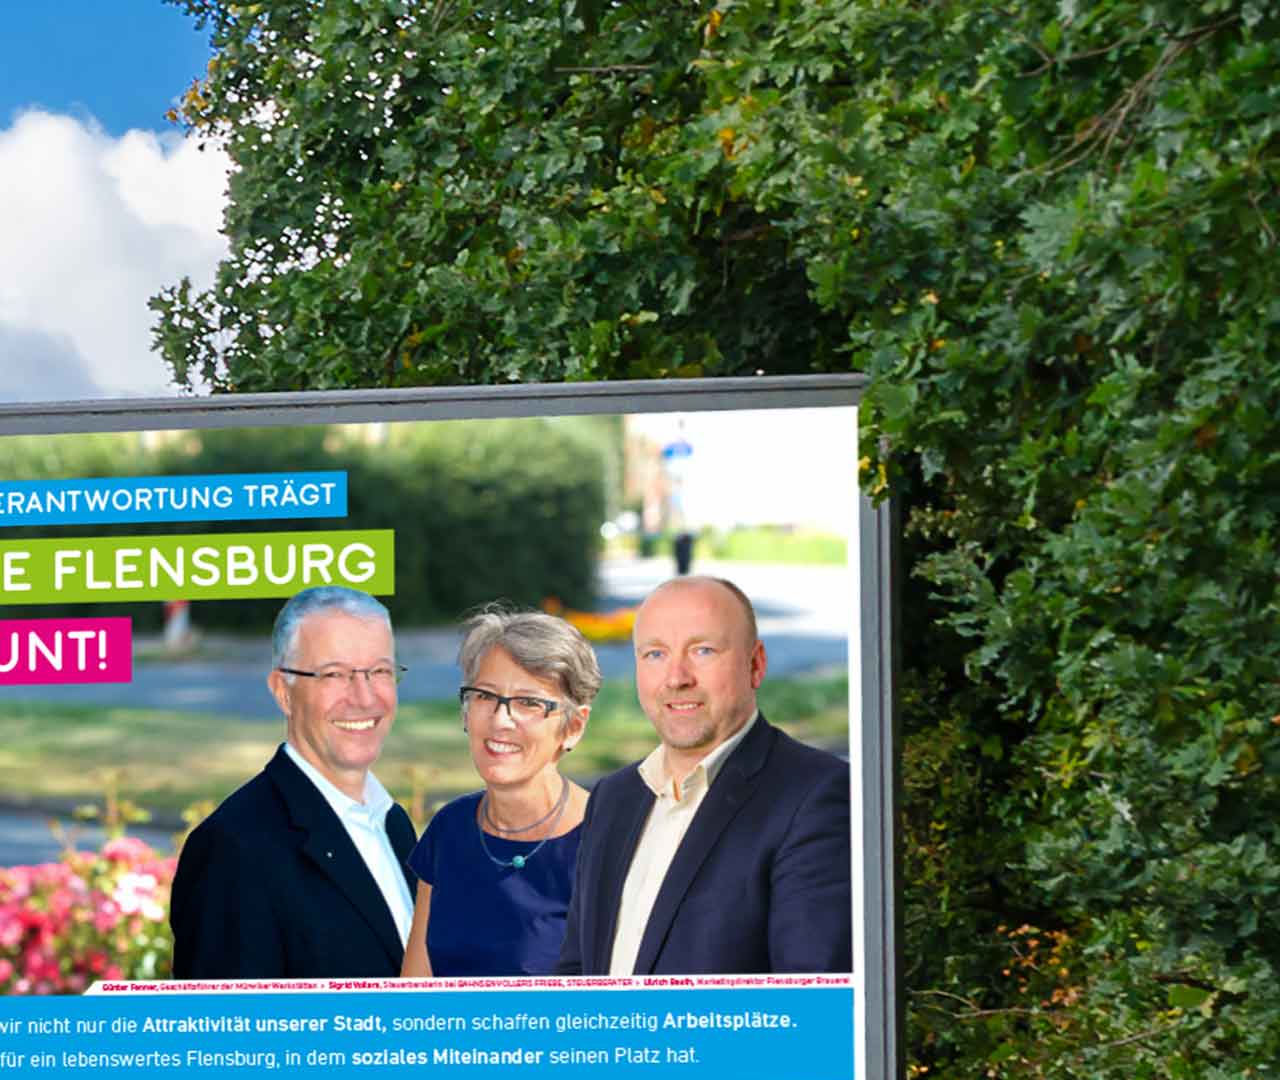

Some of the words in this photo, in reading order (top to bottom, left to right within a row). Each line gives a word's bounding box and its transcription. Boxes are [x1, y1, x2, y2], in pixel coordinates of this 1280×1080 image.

[243, 479, 336, 507] TRÄGT
[54, 542, 376, 591] FLENSBURG
[27, 1018, 71, 1034] nicht
[76, 1020, 107, 1034] nur
[111, 1017, 138, 1033] die
[142, 1016, 251, 1033] Attraktivität
[255, 1018, 329, 1032] unserer
[333, 1015, 387, 1033] Stadt,
[392, 1014, 466, 1031] sondern
[471, 1014, 550, 1030] schaffen
[555, 1013, 658, 1032] gleichzeitig
[663, 1012, 798, 1031] Arbeitsplätze.
[0, 1051, 25, 1068] für
[30, 1053, 56, 1068] ein
[62, 1051, 182, 1067] lebenswertes
[186, 1049, 280, 1068] Flensburg,
[285, 1050, 301, 1065] in
[306, 1049, 346, 1065] dem
[351, 1048, 428, 1065] soziales
[432, 1047, 544, 1065] Miteinander
[549, 1048, 609, 1064] seinen
[614, 1047, 660, 1064] Platz
[666, 1047, 700, 1064] hat.
